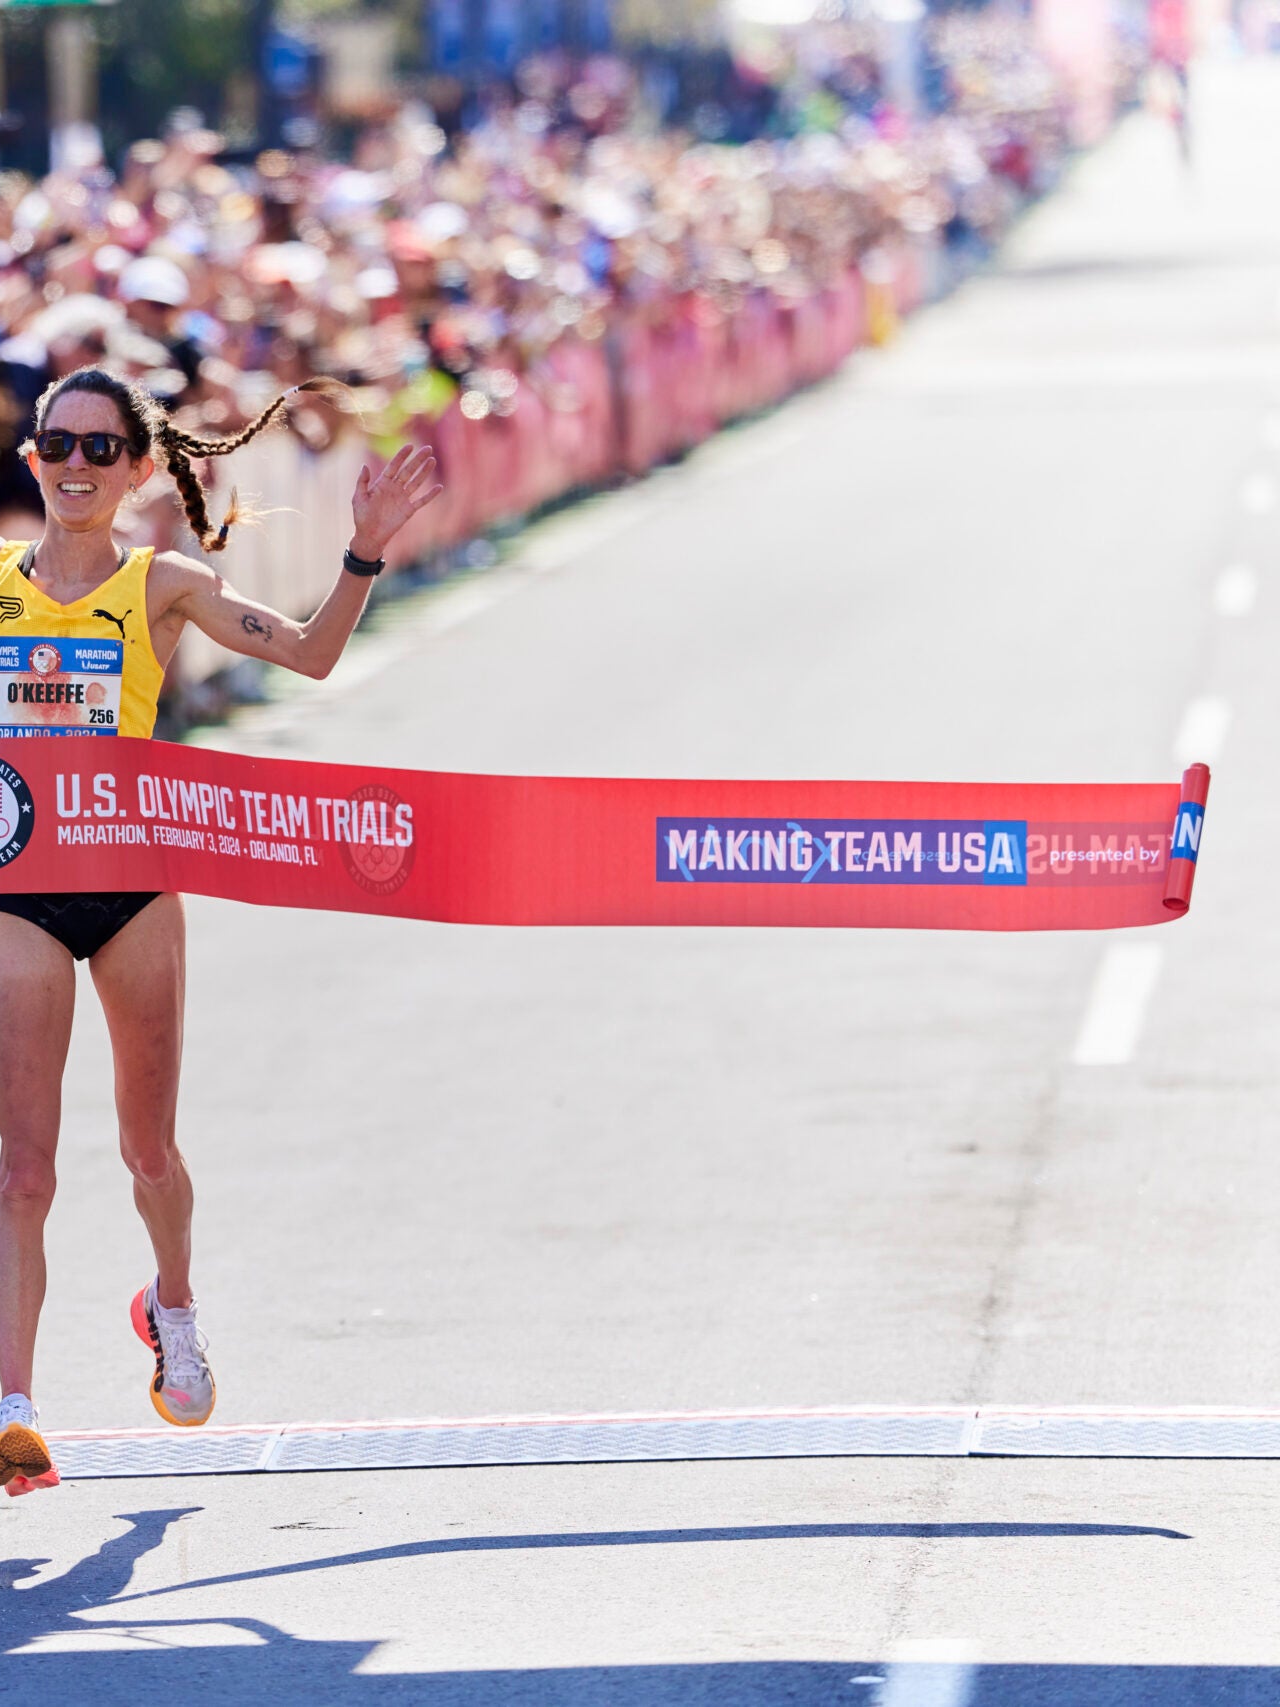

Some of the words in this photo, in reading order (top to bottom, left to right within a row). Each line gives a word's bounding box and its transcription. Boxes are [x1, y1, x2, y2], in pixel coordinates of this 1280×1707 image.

[75, 649, 118, 660] MARATHON
[7, 682, 84, 704] O'KEEFFE
[89, 708, 114, 724] 256
[56, 773, 127, 818] U.S.
[136, 774, 237, 830] OLYMPIC
[240, 789, 311, 839] TEAM
[316, 797, 414, 848] TRIALS
[57, 824, 150, 846] MARATHON,
[153, 825, 206, 851] FEBRUARY
[206, 833, 218, 854] 3,
[218, 835, 241, 856] 2024
[249, 840, 303, 866] ORLANDO,
[304, 846, 319, 866] FL
[668, 829, 813, 871] MAKING
[824, 831, 922, 872] TEAM
[937, 832, 1014, 873] USA
[1049, 846, 1134, 862] presented
[1139, 845, 1160, 864] by
